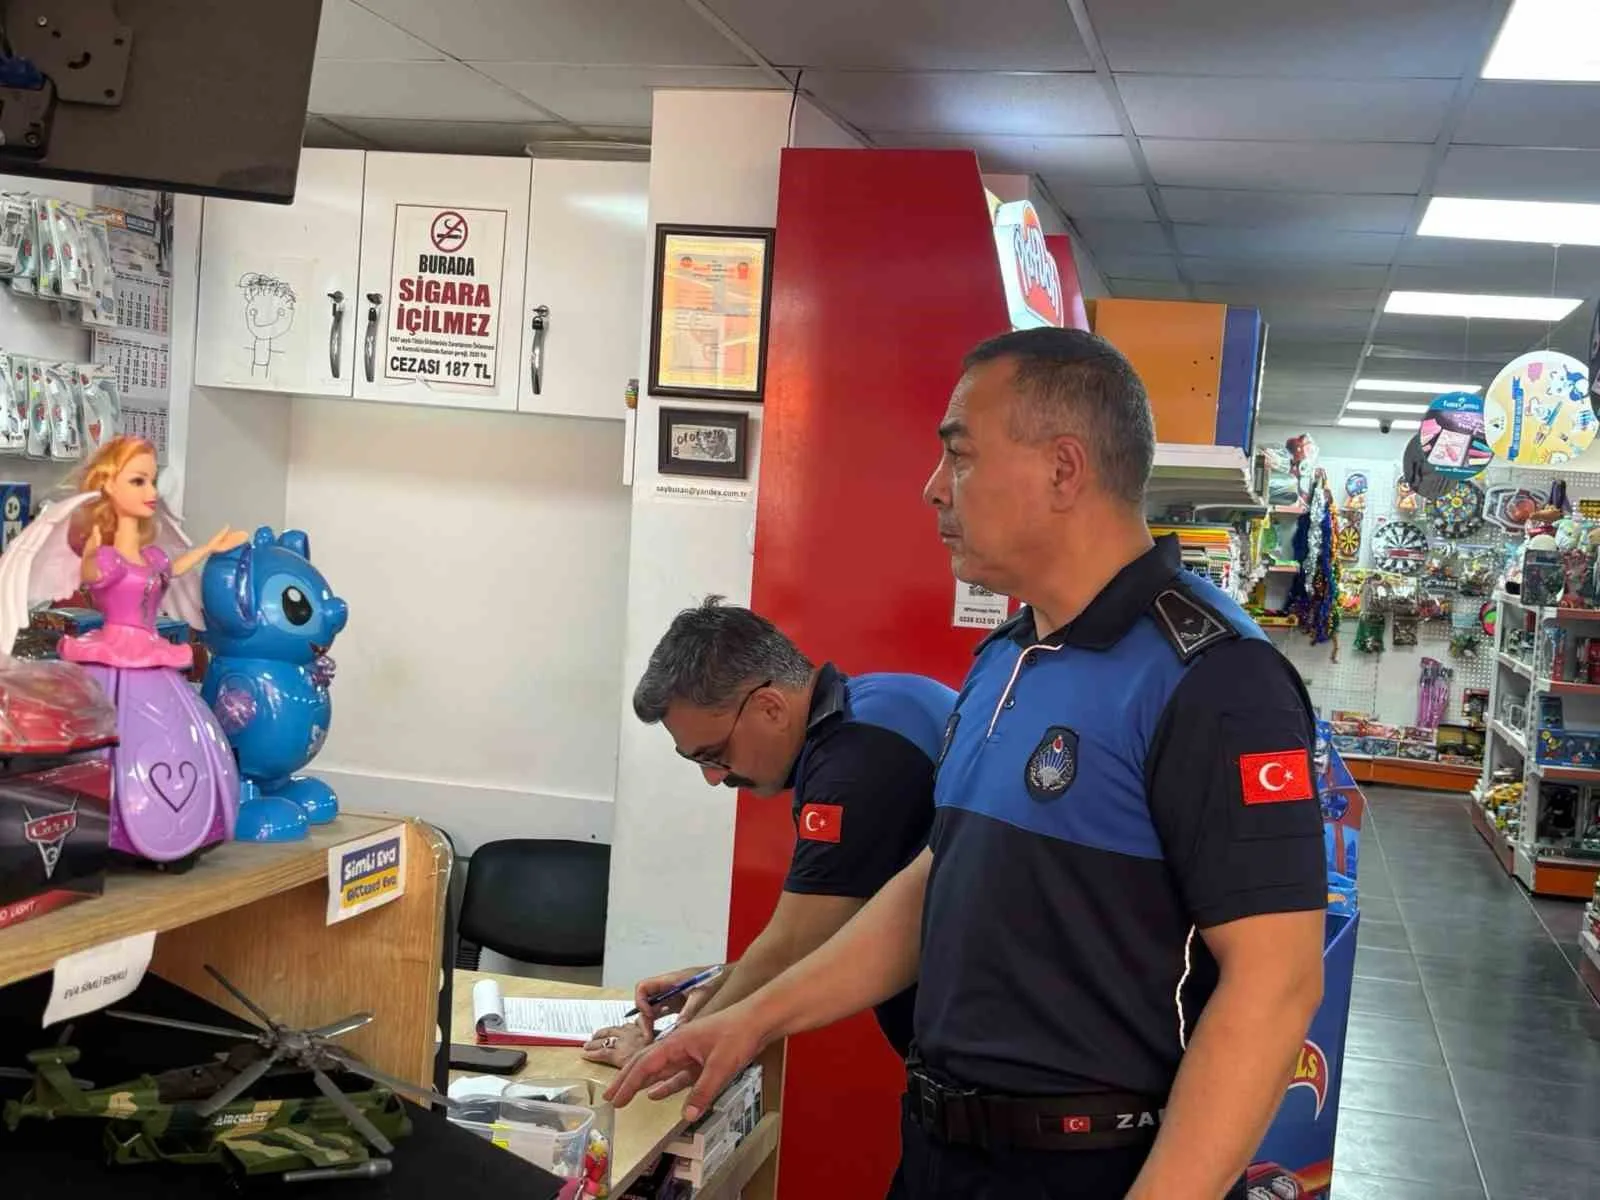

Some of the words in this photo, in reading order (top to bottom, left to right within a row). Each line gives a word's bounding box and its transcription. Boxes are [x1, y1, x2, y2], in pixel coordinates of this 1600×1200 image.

[419, 254, 475, 276] BURADA
[399, 276, 491, 307] SİGARA
[396, 304, 490, 337] İÇİLMEZ
[390, 356, 440, 375] CEZASI
[445, 361, 470, 377] 187
[474, 363, 491, 379] TL
[46, 847, 60, 866] 3
[1294, 1047, 1318, 1079] LS
